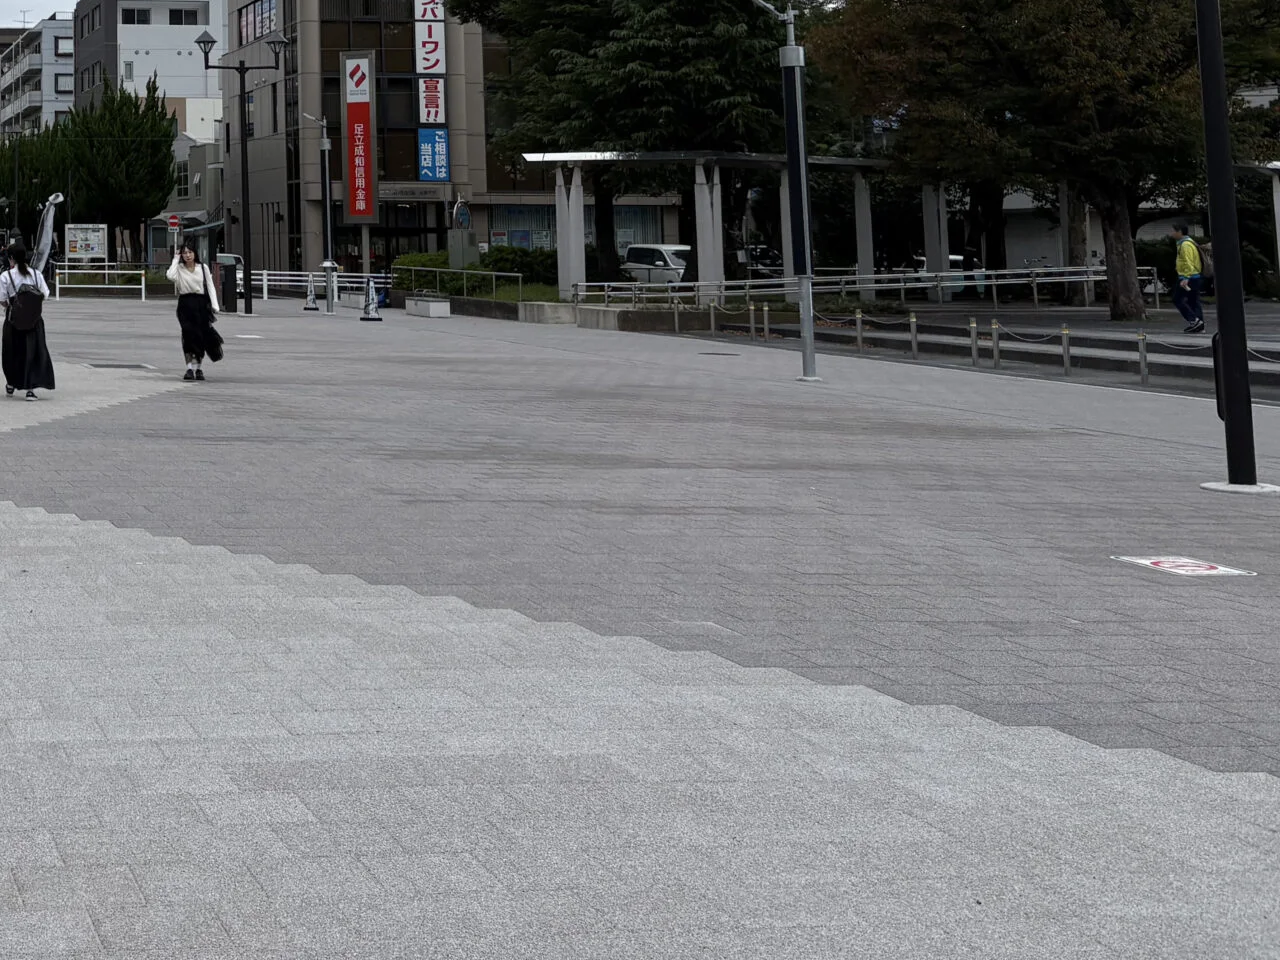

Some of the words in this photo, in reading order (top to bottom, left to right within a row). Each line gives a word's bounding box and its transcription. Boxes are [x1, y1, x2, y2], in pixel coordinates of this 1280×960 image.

[423, 79, 441, 122] 宣言!!
[353, 123, 366, 211] 足立成和信用金庫
[420, 142, 433, 177] 当店へ
[435, 130, 447, 179] ご相談は
